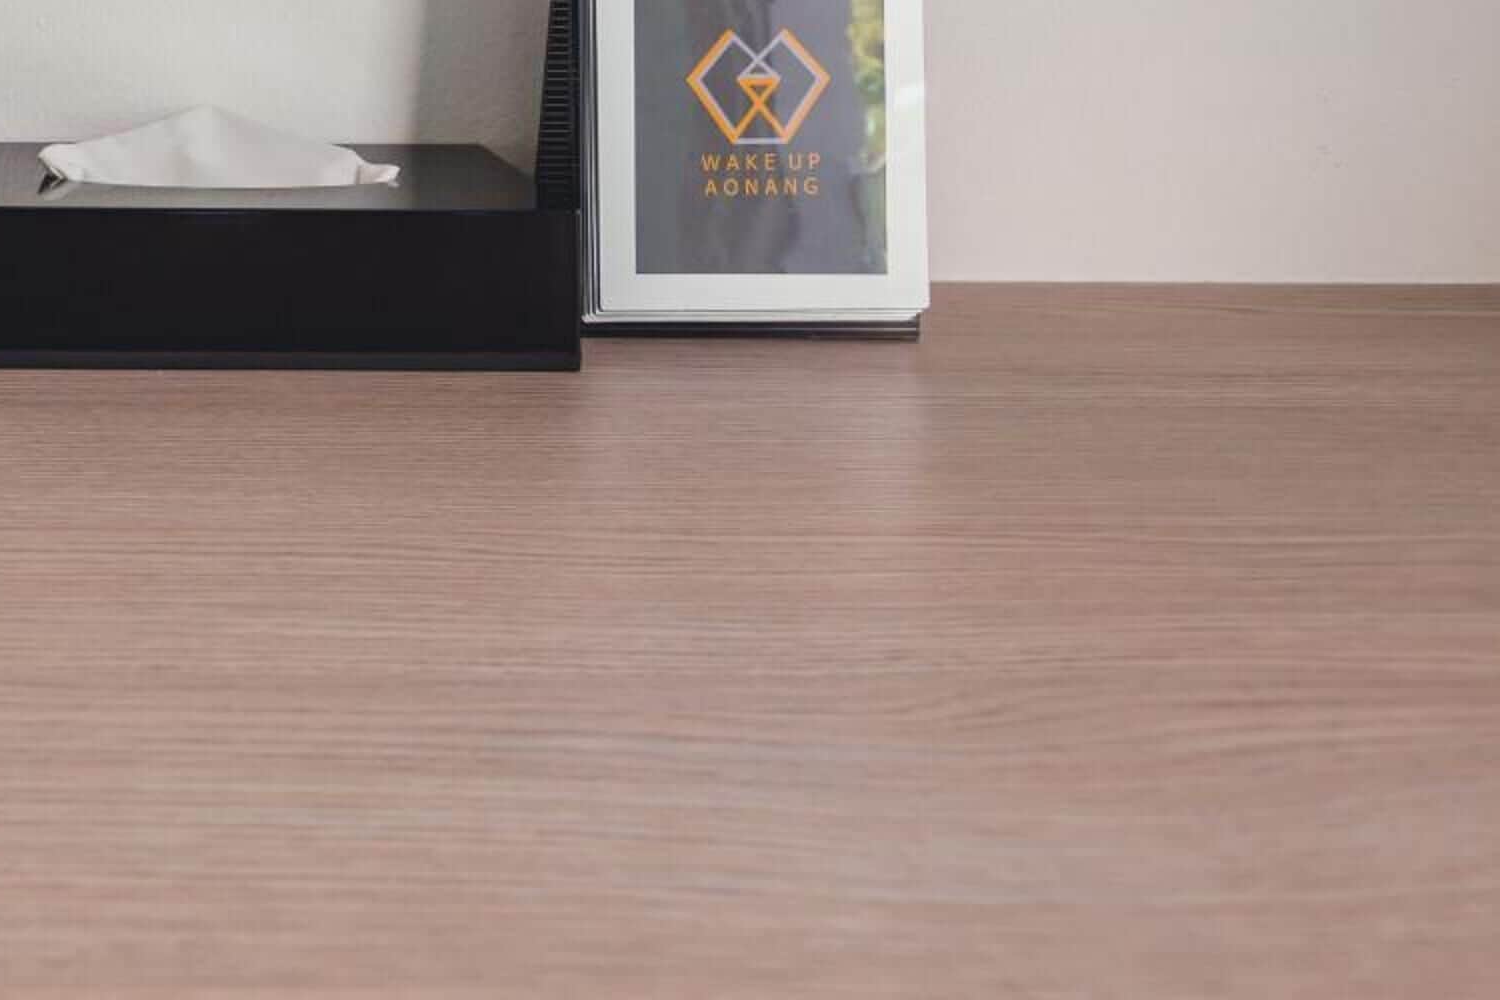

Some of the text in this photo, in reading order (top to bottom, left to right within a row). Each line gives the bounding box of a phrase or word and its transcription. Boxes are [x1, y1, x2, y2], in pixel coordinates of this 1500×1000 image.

[701, 152, 820, 171] WAKE UP
[705, 178, 819, 196] AONANG
